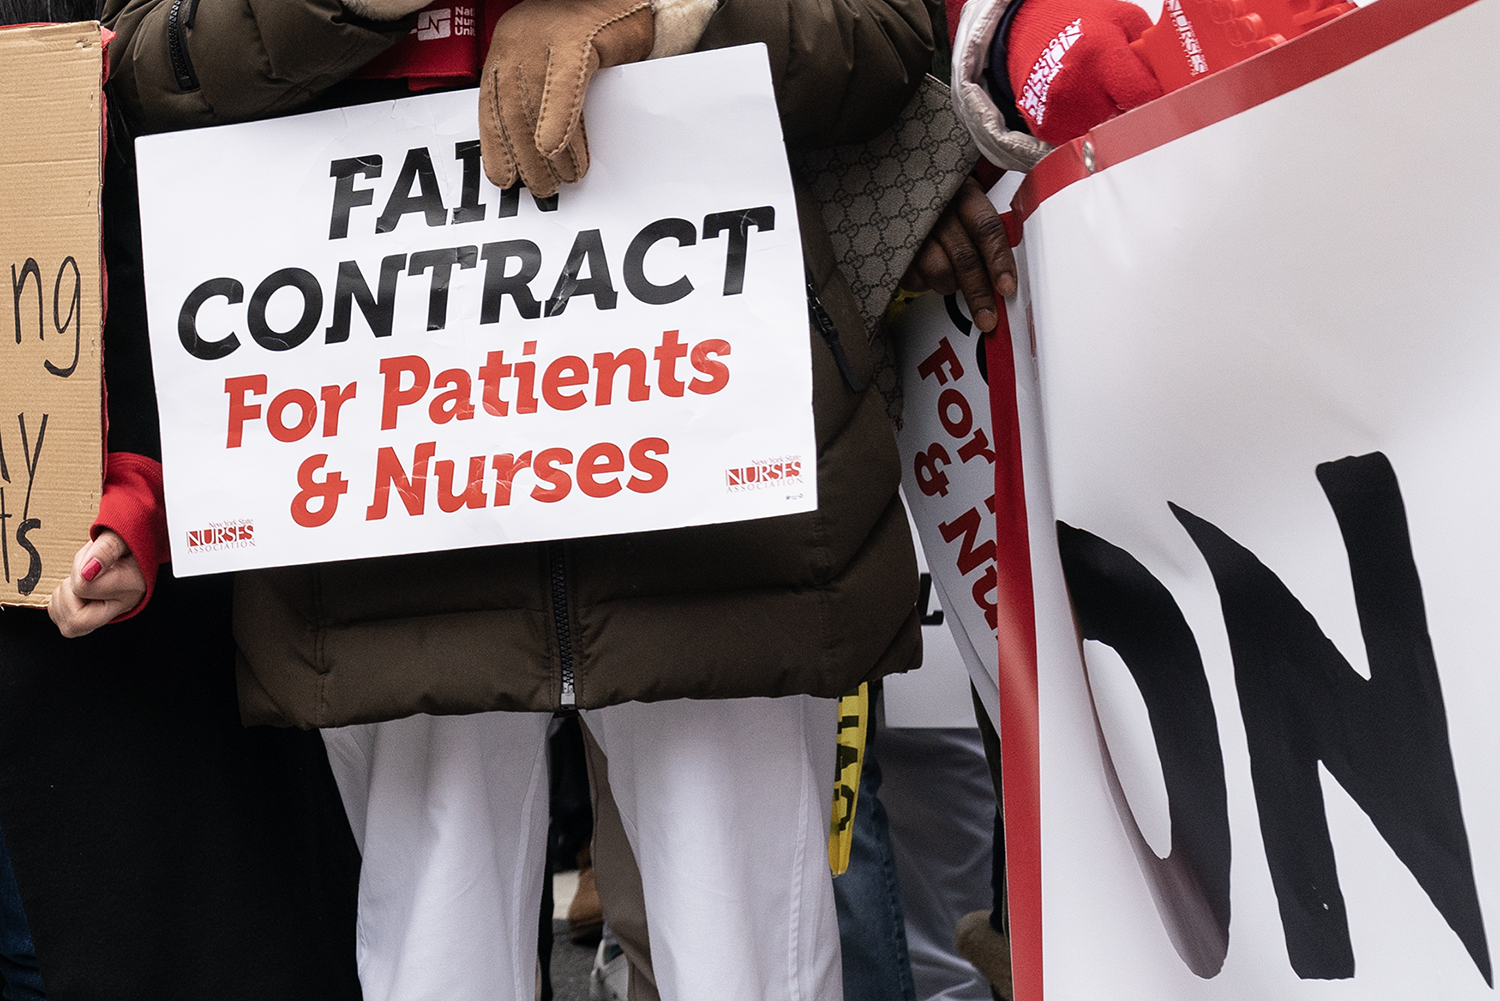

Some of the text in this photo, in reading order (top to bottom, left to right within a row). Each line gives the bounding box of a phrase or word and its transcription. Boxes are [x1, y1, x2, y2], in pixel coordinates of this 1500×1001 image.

[177, 205, 775, 361] CONTRACT
[224, 329, 731, 448] For Patients
[290, 437, 670, 528] & Nurses
[725, 460, 802, 487] NURSES
[726, 474, 803, 493] ASSOCIATION
[914, 442, 952, 498] &
[186, 524, 255, 548] NURSES
[188, 538, 257, 554] ASSOCIATION
